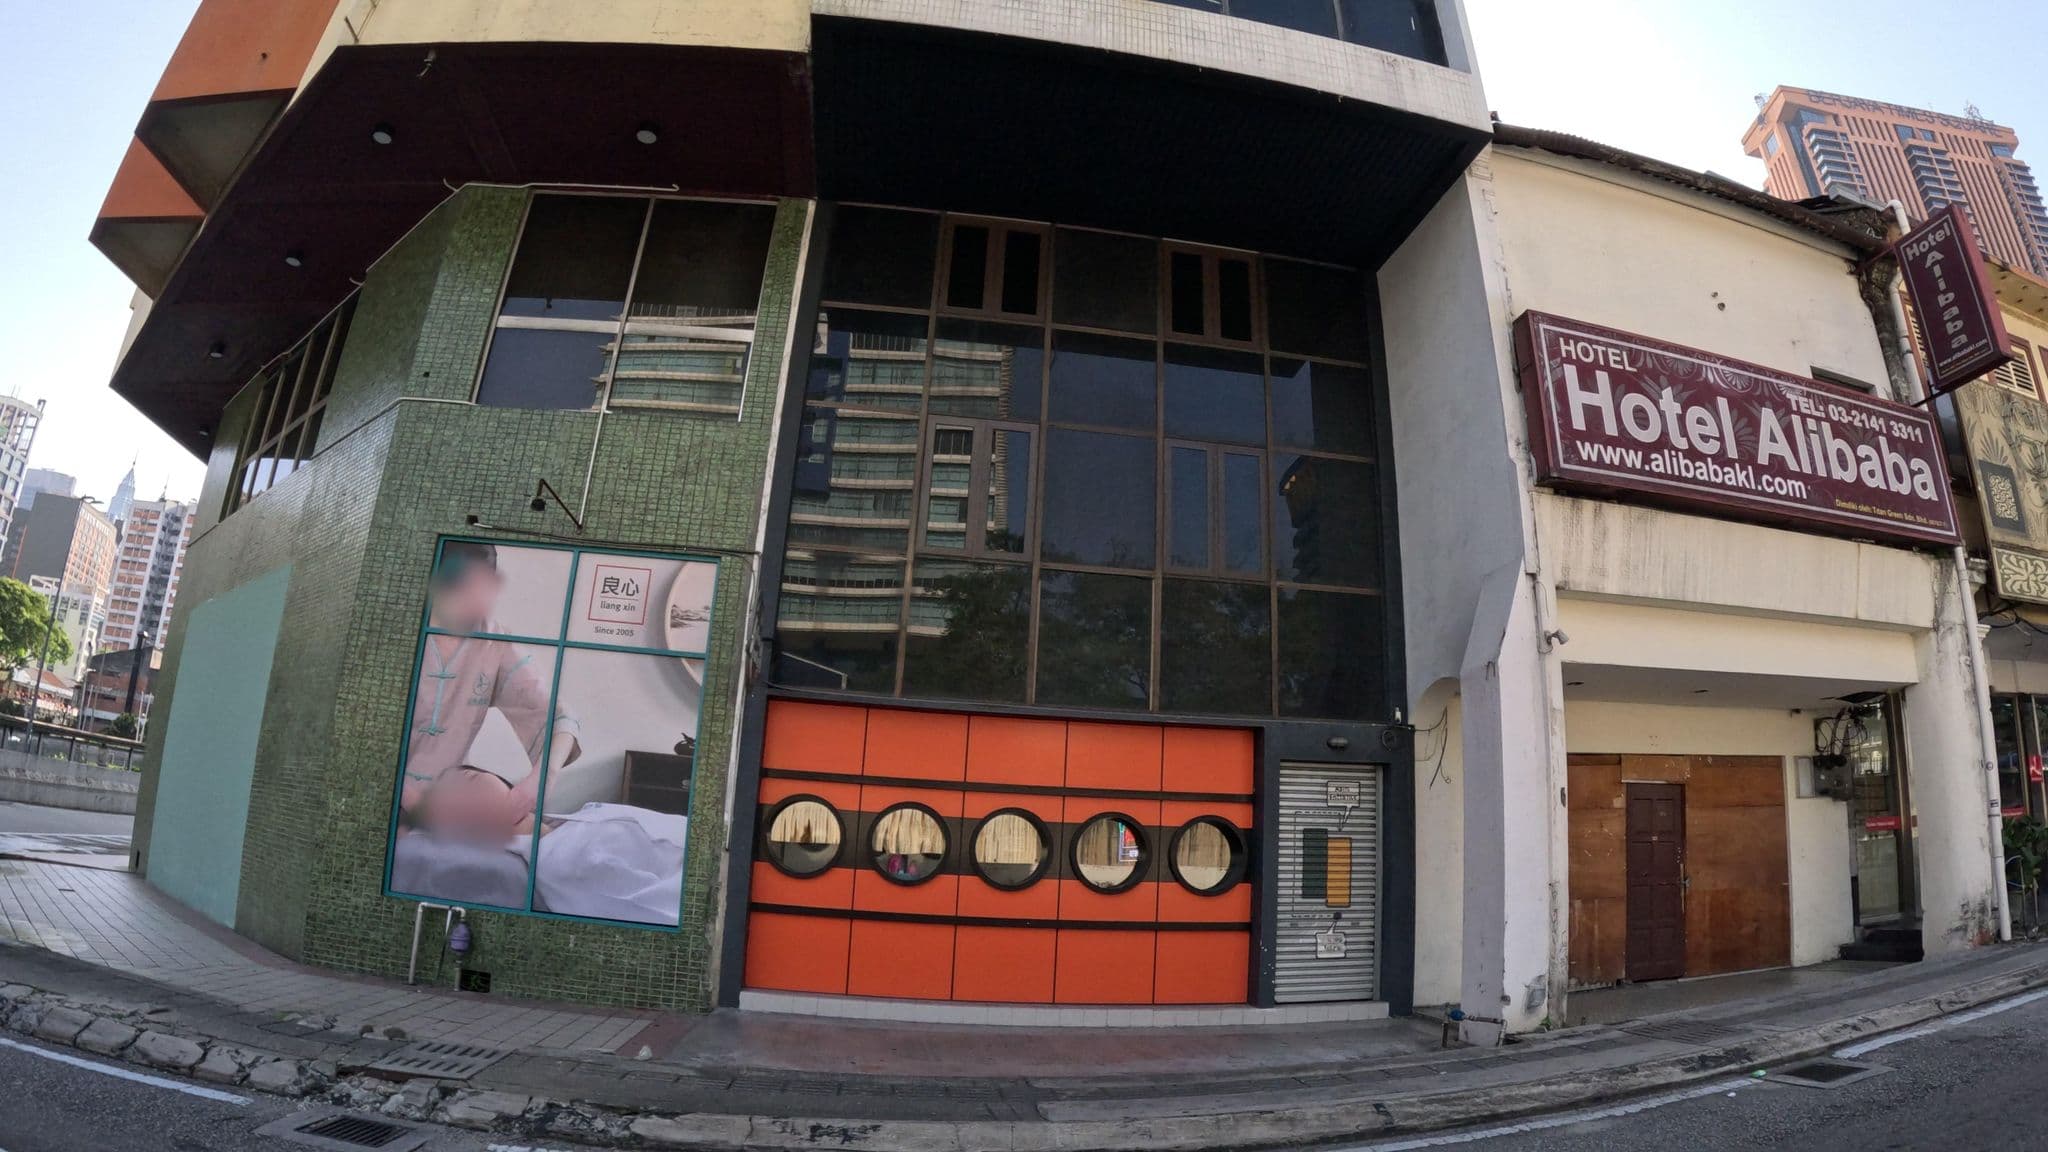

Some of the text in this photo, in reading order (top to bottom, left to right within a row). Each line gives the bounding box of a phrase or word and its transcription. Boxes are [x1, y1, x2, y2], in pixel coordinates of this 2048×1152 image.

[1906, 222, 1951, 261] Hotel
[1924, 250, 1968, 349] Alibaba
[1559, 337, 1638, 372] HOTEL
[1563, 363, 1939, 502] Hotel Alibaba
[1786, 393, 1924, 444] TEL: 03-2141 3311
[1576, 440, 1808, 499] www.alibabakl.com
[600, 600, 636, 612] liang xin
[601, 576, 640, 597] 良心
[594, 625, 635, 637] Since 2005
